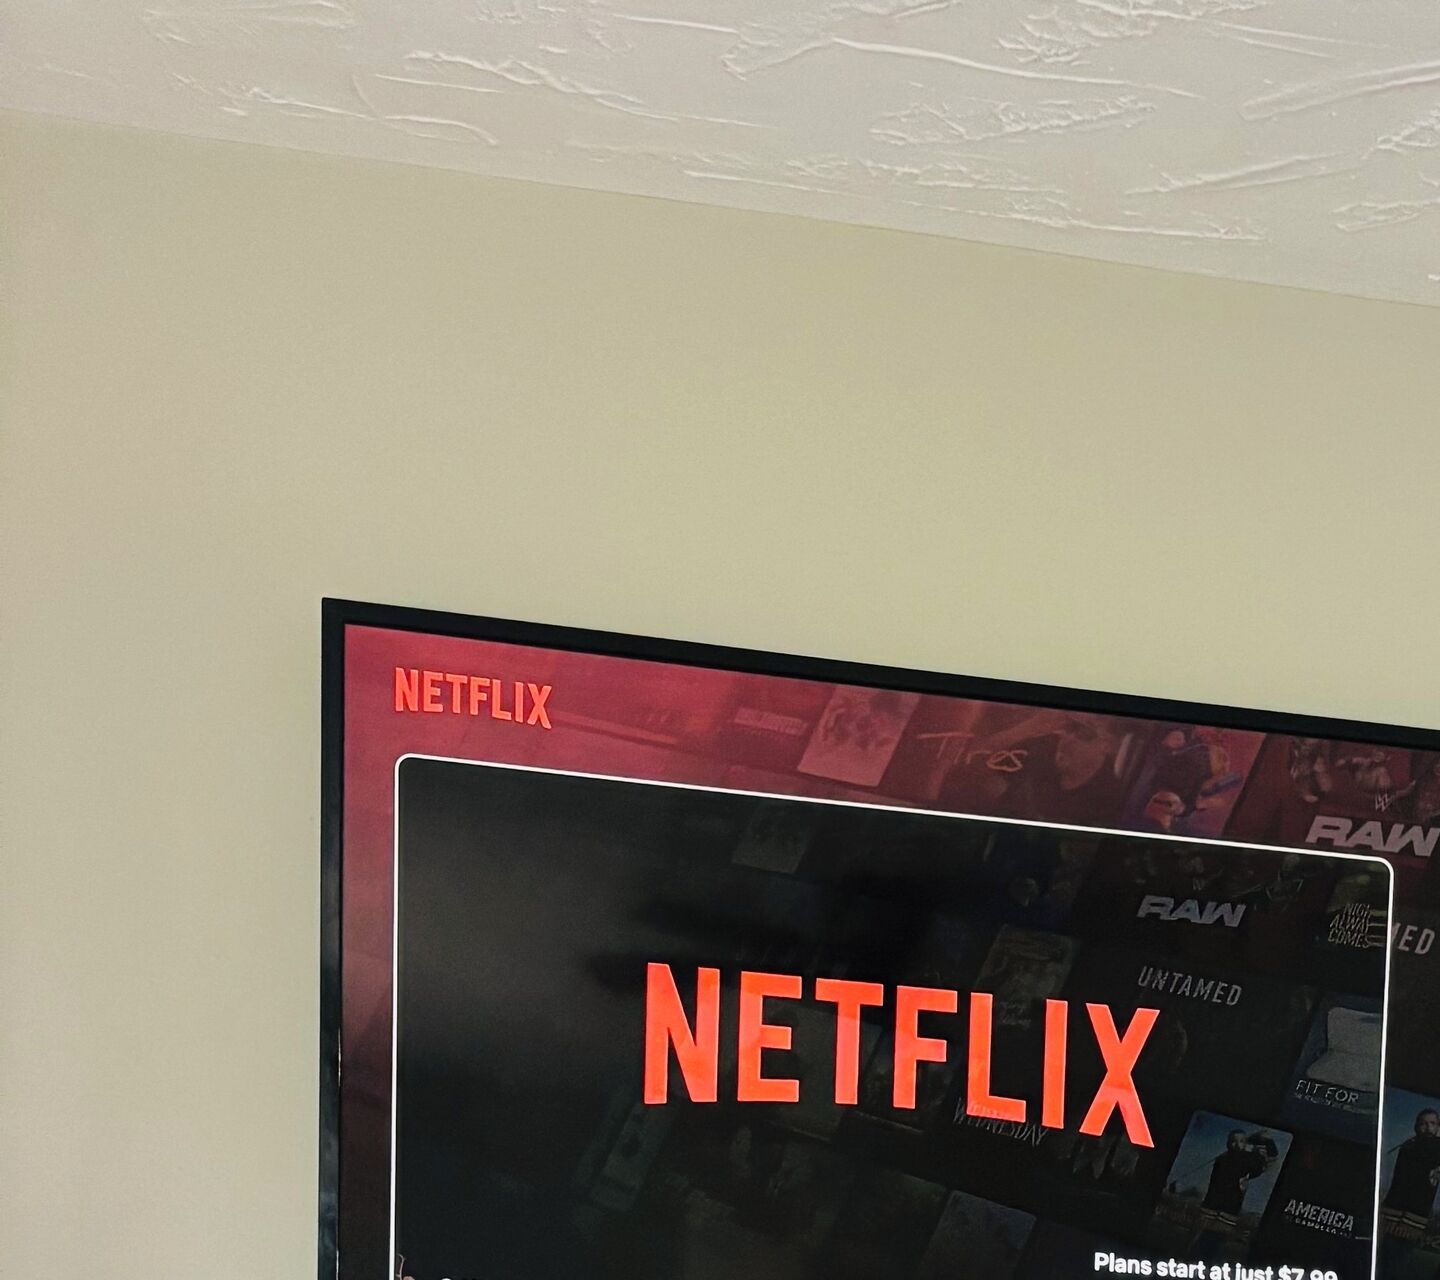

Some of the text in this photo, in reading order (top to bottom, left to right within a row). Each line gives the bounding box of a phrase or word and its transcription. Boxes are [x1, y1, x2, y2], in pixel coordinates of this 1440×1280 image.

[394, 666, 552, 729] NETFLIX
[1305, 814, 1440, 857] RAW
[1137, 895, 1246, 928] RAW
[1137, 966, 1243, 1006] UNTAMED
[643, 961, 1160, 1149] NETFLIX
[1284, 1199, 1354, 1232] AMERICA
[1093, 1252, 1152, 1276] Plans
